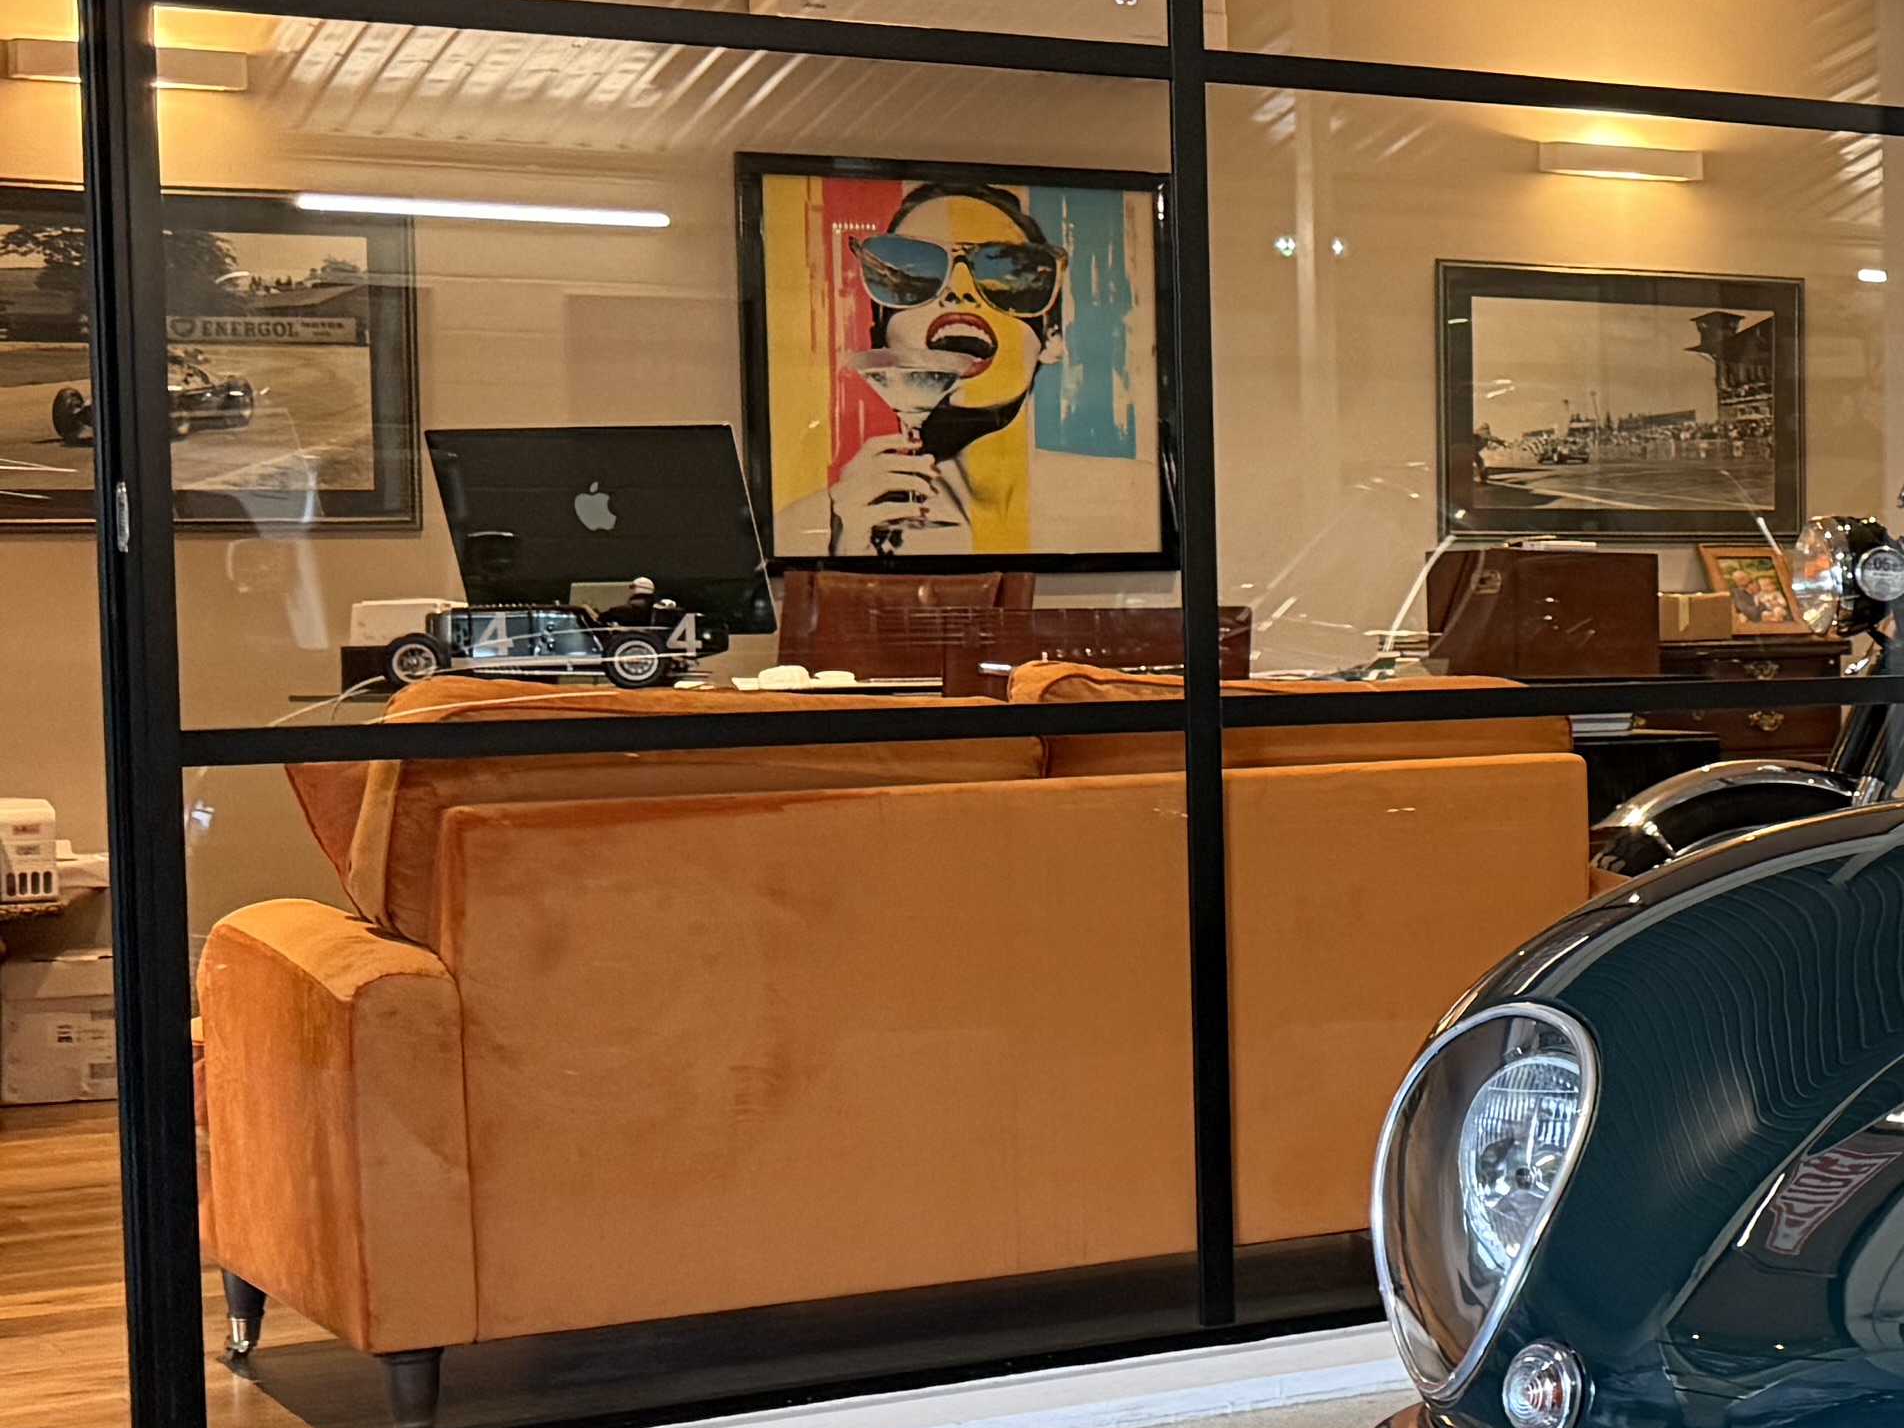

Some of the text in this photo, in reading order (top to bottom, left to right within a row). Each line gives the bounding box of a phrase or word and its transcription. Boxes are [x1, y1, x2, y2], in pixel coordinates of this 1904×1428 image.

[202, 321, 298, 338] ENERGOL
[479, 611, 515, 657] 4
[666, 612, 703, 658] 4
